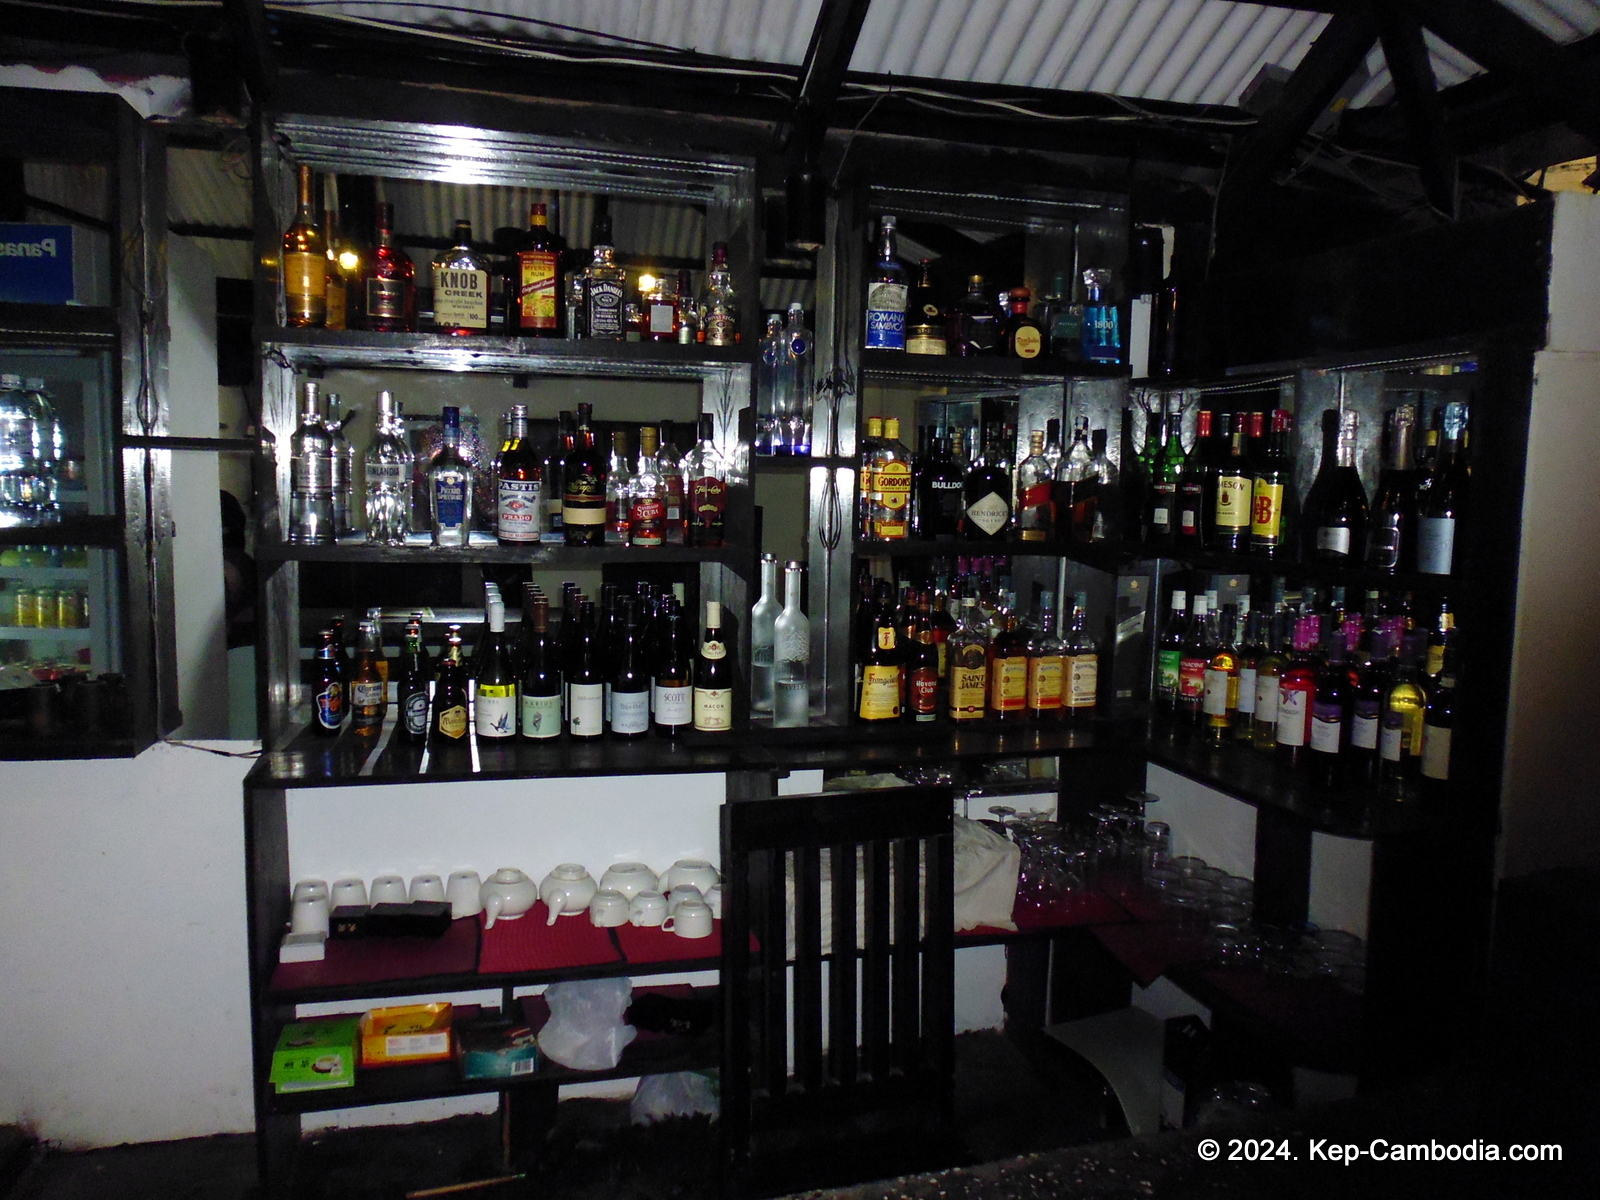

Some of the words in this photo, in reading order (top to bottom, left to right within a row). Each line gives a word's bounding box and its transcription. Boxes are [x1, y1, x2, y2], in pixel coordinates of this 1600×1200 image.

[440, 271, 478, 290] KNOB
[444, 289, 483, 299] CREEK
[869, 311, 905, 322] ROMANA
[1095, 319, 1114, 330] 1800
[367, 466, 400, 477] FINLANDIA
[499, 481, 540, 491] PASTIS
[877, 475, 910, 487] GORDON'S
[931, 481, 963, 489] BULLDO
[502, 513, 531, 521] PRADO
[961, 673, 986, 683] SAINT
[915, 679, 937, 688] Havana
[958, 681, 985, 690] JAMES
[920, 686, 934, 694] Club
[663, 692, 686, 702] SCOTT
